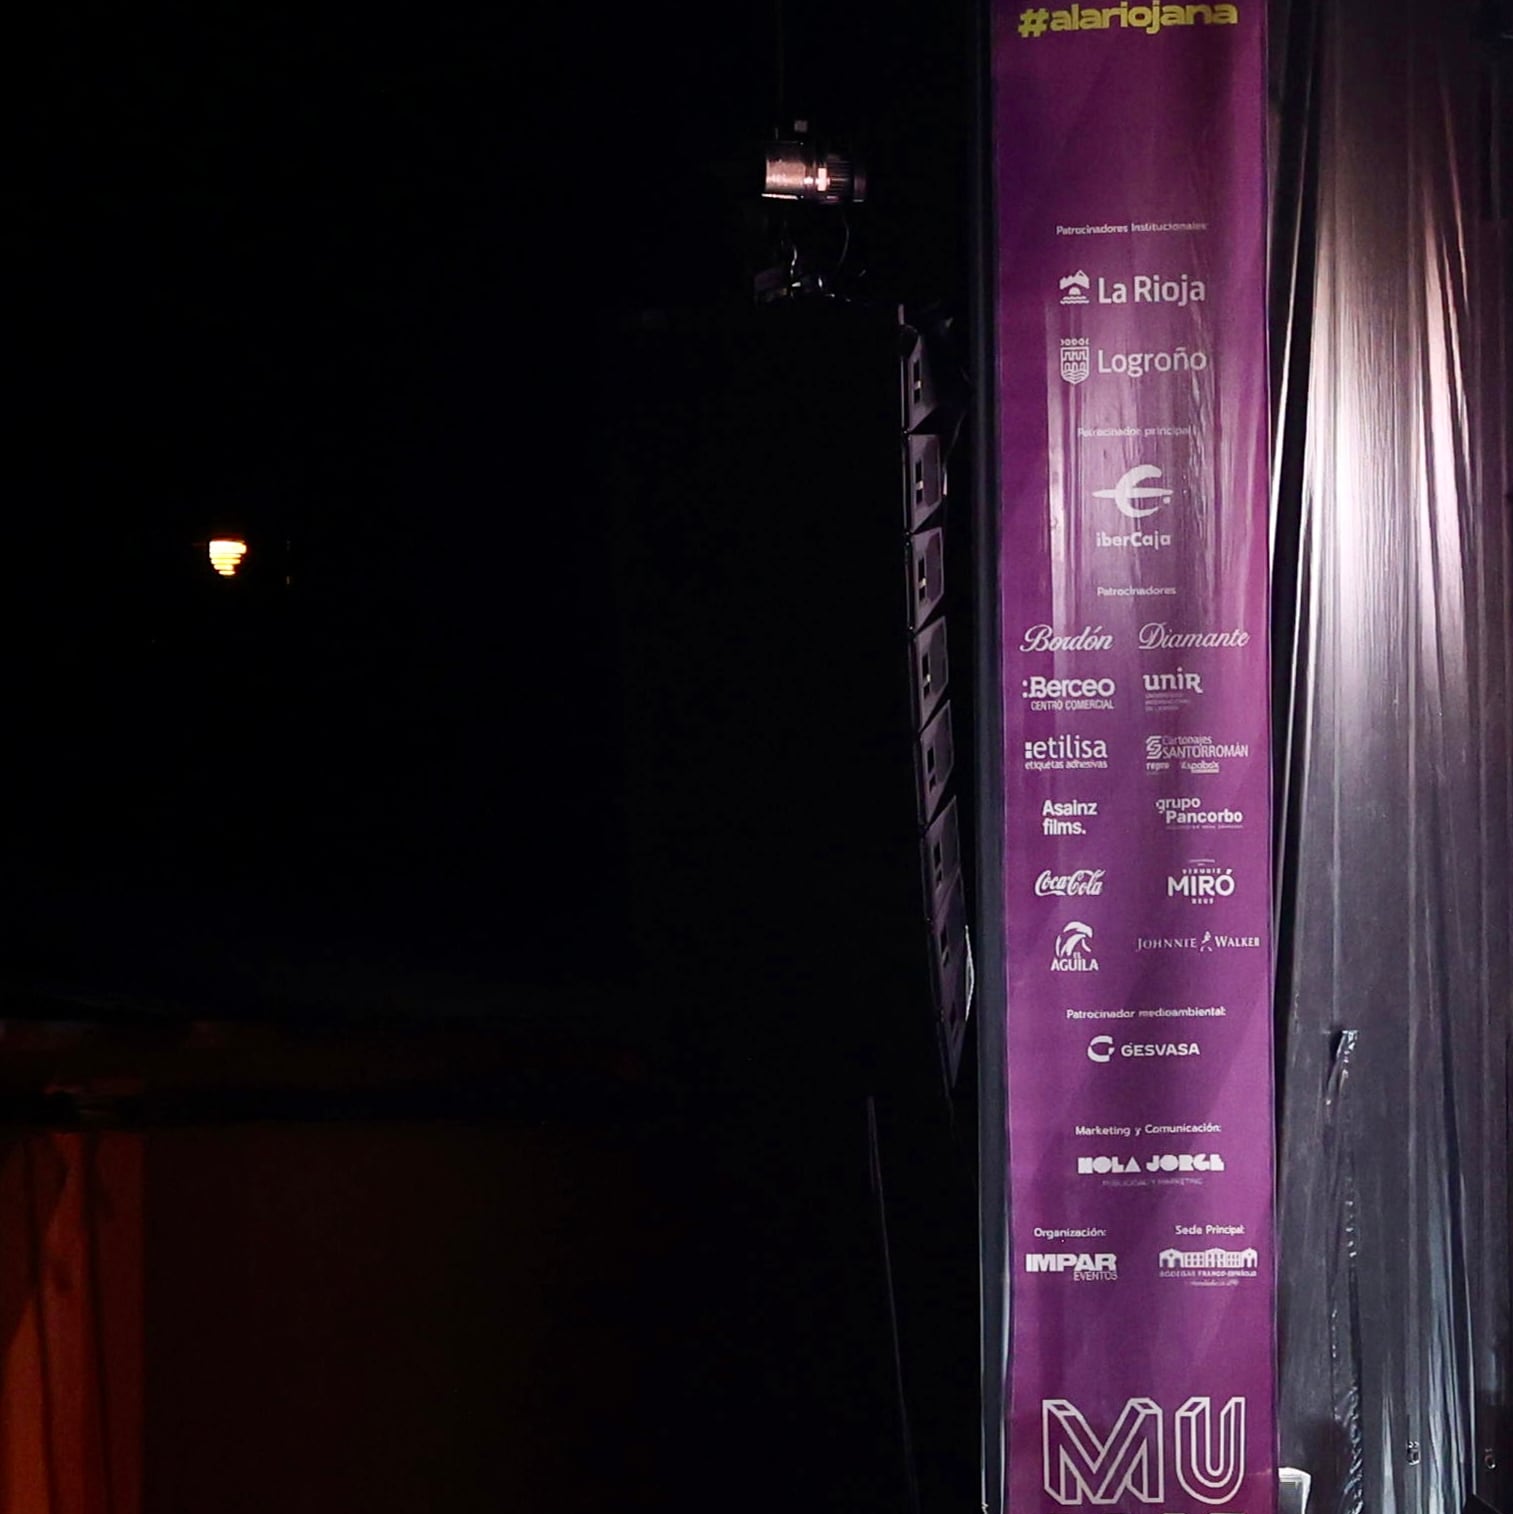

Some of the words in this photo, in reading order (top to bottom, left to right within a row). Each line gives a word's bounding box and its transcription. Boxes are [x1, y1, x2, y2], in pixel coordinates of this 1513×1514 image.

[1018, 2, 1238, 38] #alariojana
[1056, 223, 1128, 235] Patrocinadores
[1098, 277, 1127, 304] La
[1133, 274, 1206, 306] Rioja
[1098, 347, 1207, 377] Logroño
[1096, 531, 1171, 549] iberCaja
[1020, 624, 1114, 652] Bordón
[1138, 622, 1250, 650] Diamante
[1031, 700, 1064, 711] CENTRO
[1065, 698, 1115, 710] COMERCIAL
[1162, 742, 1248, 759] SANTORROMÁN
[1042, 800, 1098, 816] Asainz
[1156, 798, 1201, 814] grupo
[1165, 808, 1243, 824] Pancorbo
[1167, 868, 1235, 896] MIRÓ
[1066, 1008, 1134, 1019] Patrocinador
[1120, 1043, 1201, 1058] GESVASA
[1075, 1125, 1131, 1137] Marketing
[1134, 1128, 1142, 1137] y
[1078, 1156, 1141, 1174] HOLA
[1146, 1154, 1225, 1172] JORGE
[1175, 1224, 1202, 1235] Sede
[1026, 1253, 1117, 1272] IMPAR
[1073, 1271, 1118, 1281] EVENTOS
